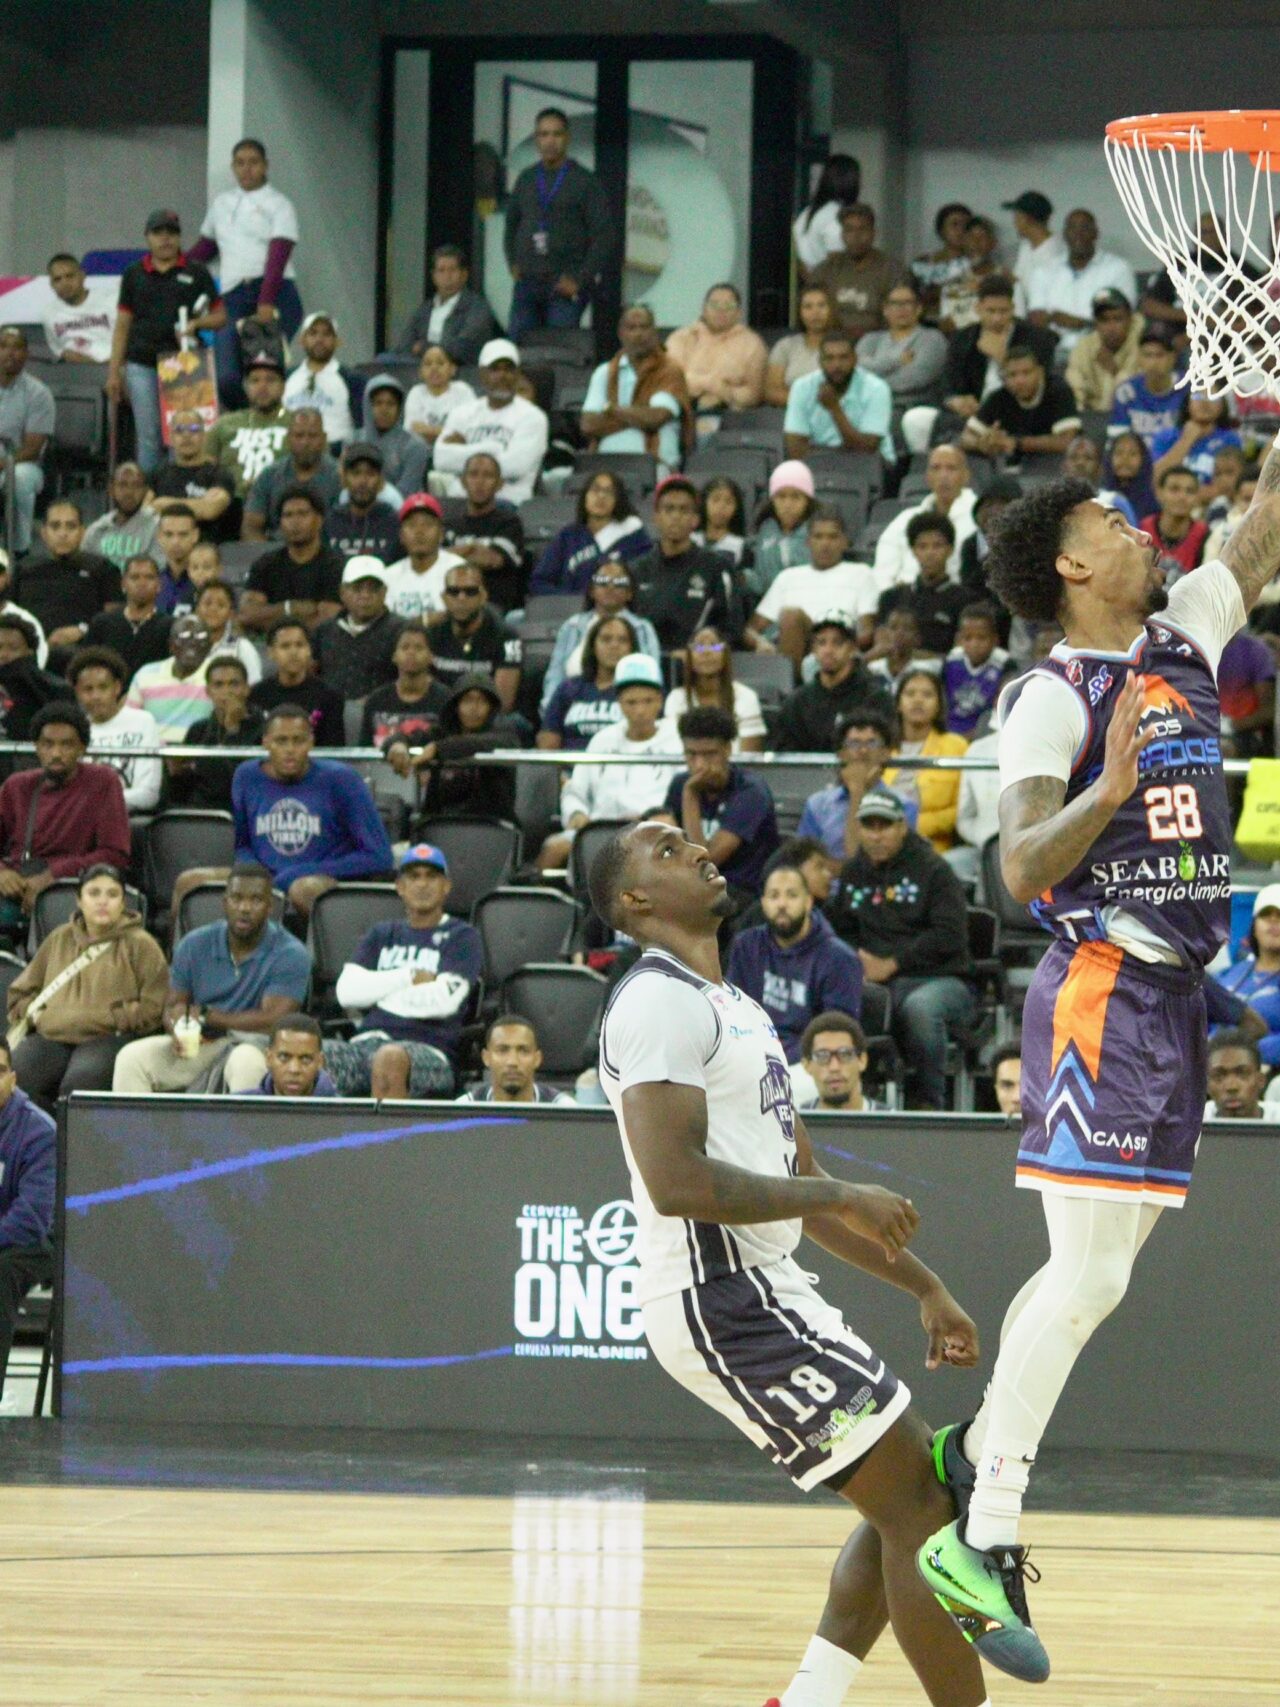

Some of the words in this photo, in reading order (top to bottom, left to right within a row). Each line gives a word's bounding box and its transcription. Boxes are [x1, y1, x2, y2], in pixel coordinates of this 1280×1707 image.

[230, 427, 288, 450] JUST
[563, 700, 622, 727] MILLO
[256, 811, 320, 836] MILLON
[1144, 783, 1203, 840] 28
[1092, 1131, 1148, 1155] CAASD
[522, 1204, 578, 1218] CERVEZA
[515, 1216, 584, 1262] THE
[514, 1262, 646, 1341] ONE
[571, 1344, 648, 1360] PILSNER
[765, 1363, 838, 1424] 18
